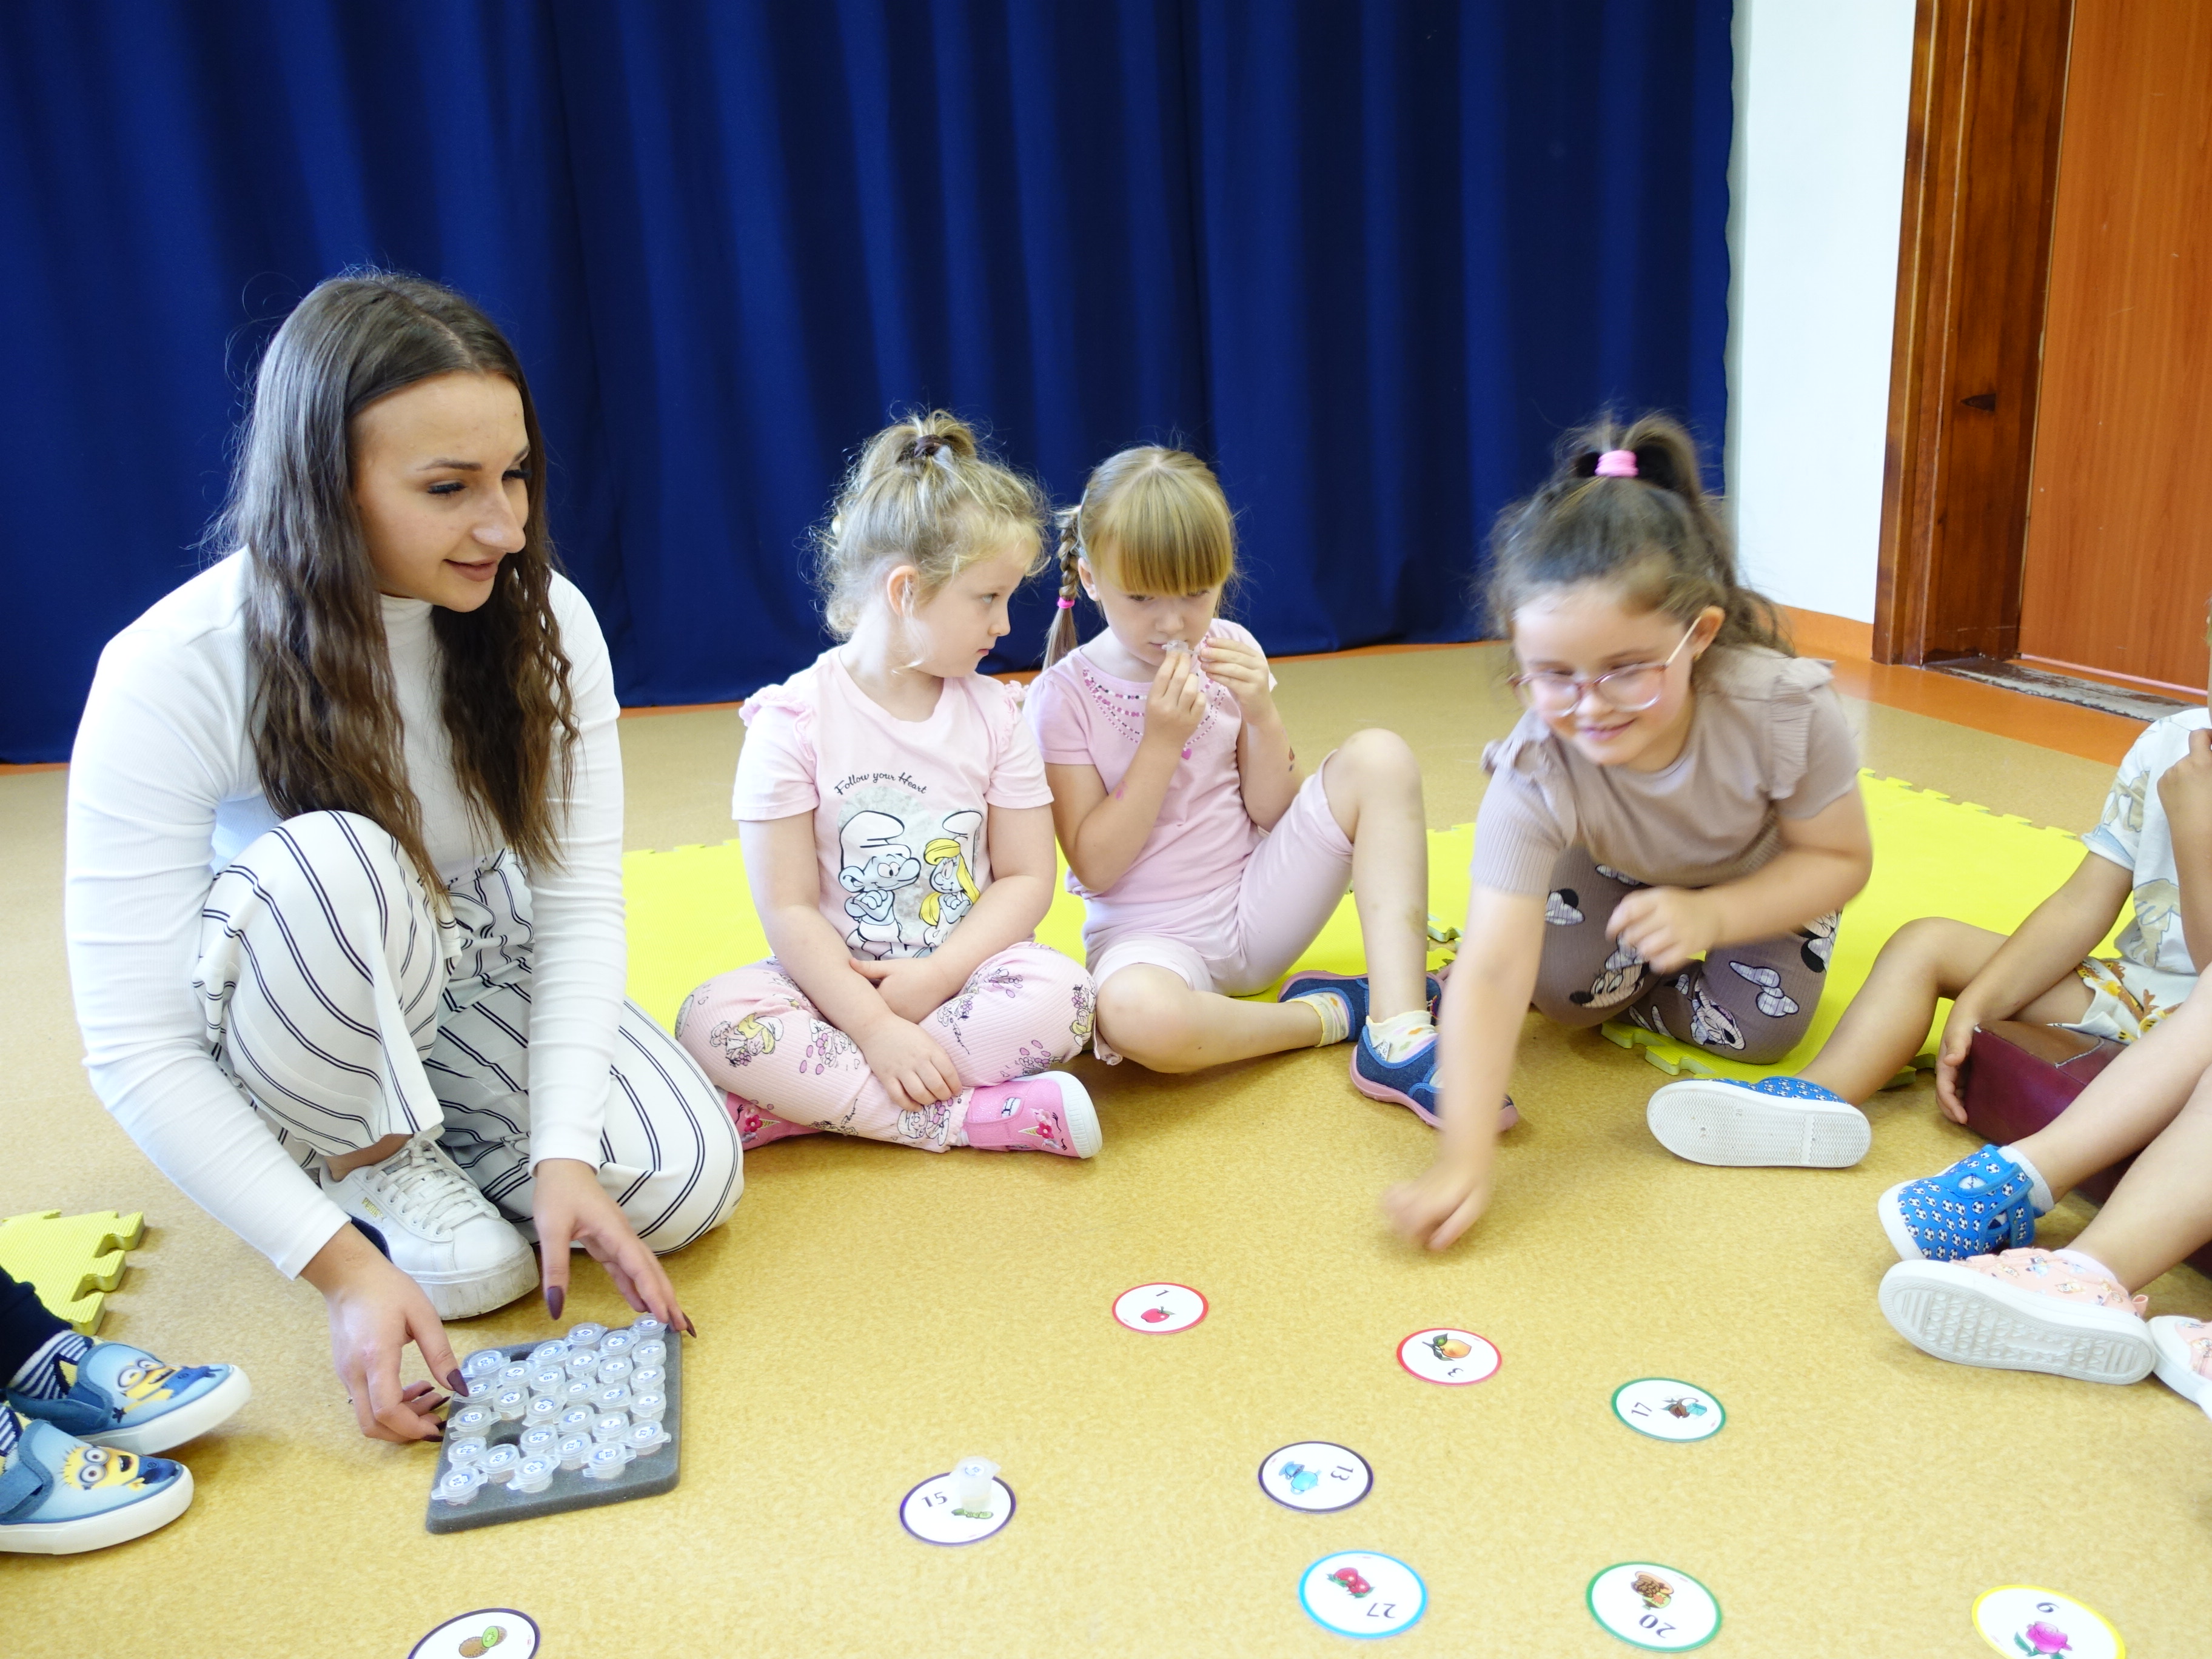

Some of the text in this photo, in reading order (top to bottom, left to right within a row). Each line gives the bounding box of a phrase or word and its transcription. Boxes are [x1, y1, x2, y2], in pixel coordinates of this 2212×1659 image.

[834, 772, 927, 795] Follow your Heart
[1447, 1367, 1464, 1377] 3
[1631, 1401, 1652, 1417] 17
[1330, 1465, 1353, 1481] 13
[921, 1491, 948, 1507] 15
[1366, 1603, 1396, 1618] 27
[1638, 1614, 1676, 1638] 20
